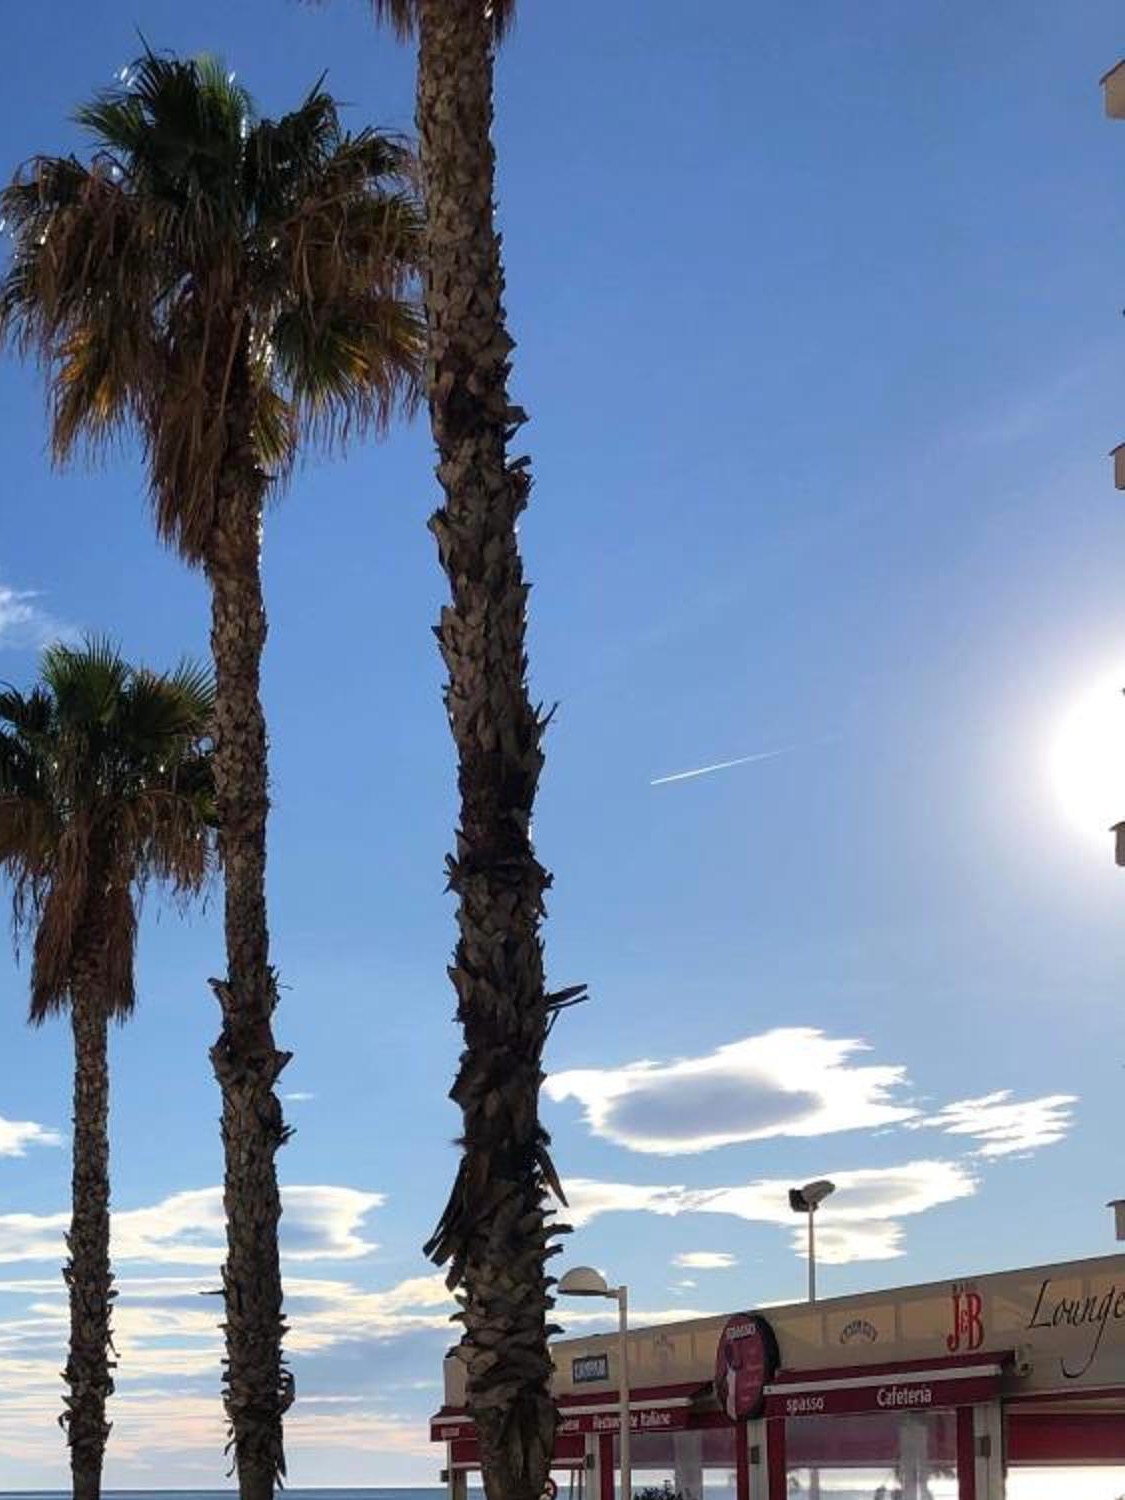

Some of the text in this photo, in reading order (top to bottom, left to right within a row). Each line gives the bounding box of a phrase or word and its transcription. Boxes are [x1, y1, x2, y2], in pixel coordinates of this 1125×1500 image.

[946, 1292, 984, 1352] J&B
[1027, 1279, 1125, 1378] Lounge
[786, 1396, 824, 1414] spasso
